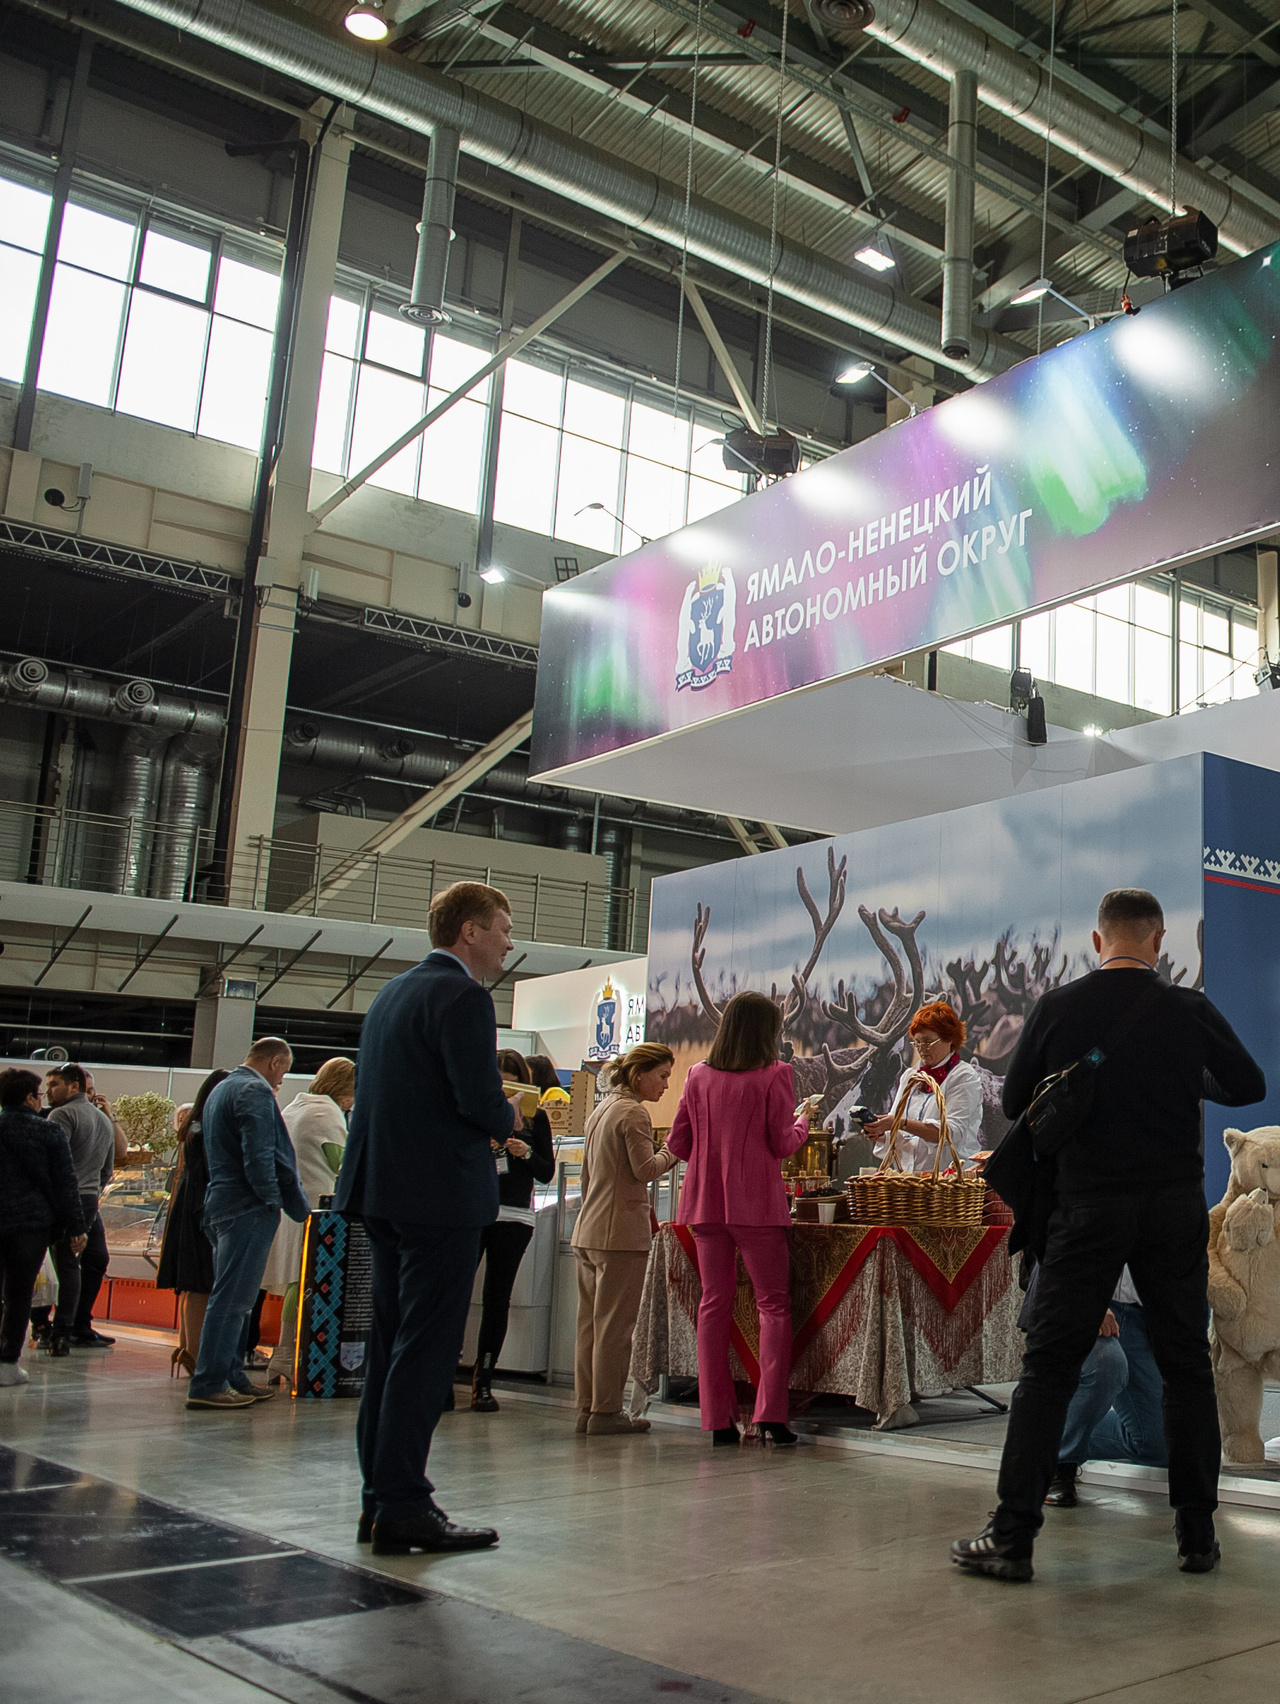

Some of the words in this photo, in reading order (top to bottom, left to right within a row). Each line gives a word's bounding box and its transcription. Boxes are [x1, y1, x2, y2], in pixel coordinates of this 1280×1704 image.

[743, 543, 928, 653] АВТОНОМНЫЙ
[937, 508, 1033, 577] ОКРУГ
[746, 464, 991, 605] ЯМАЛО-НЕНЕЦКИЙ
